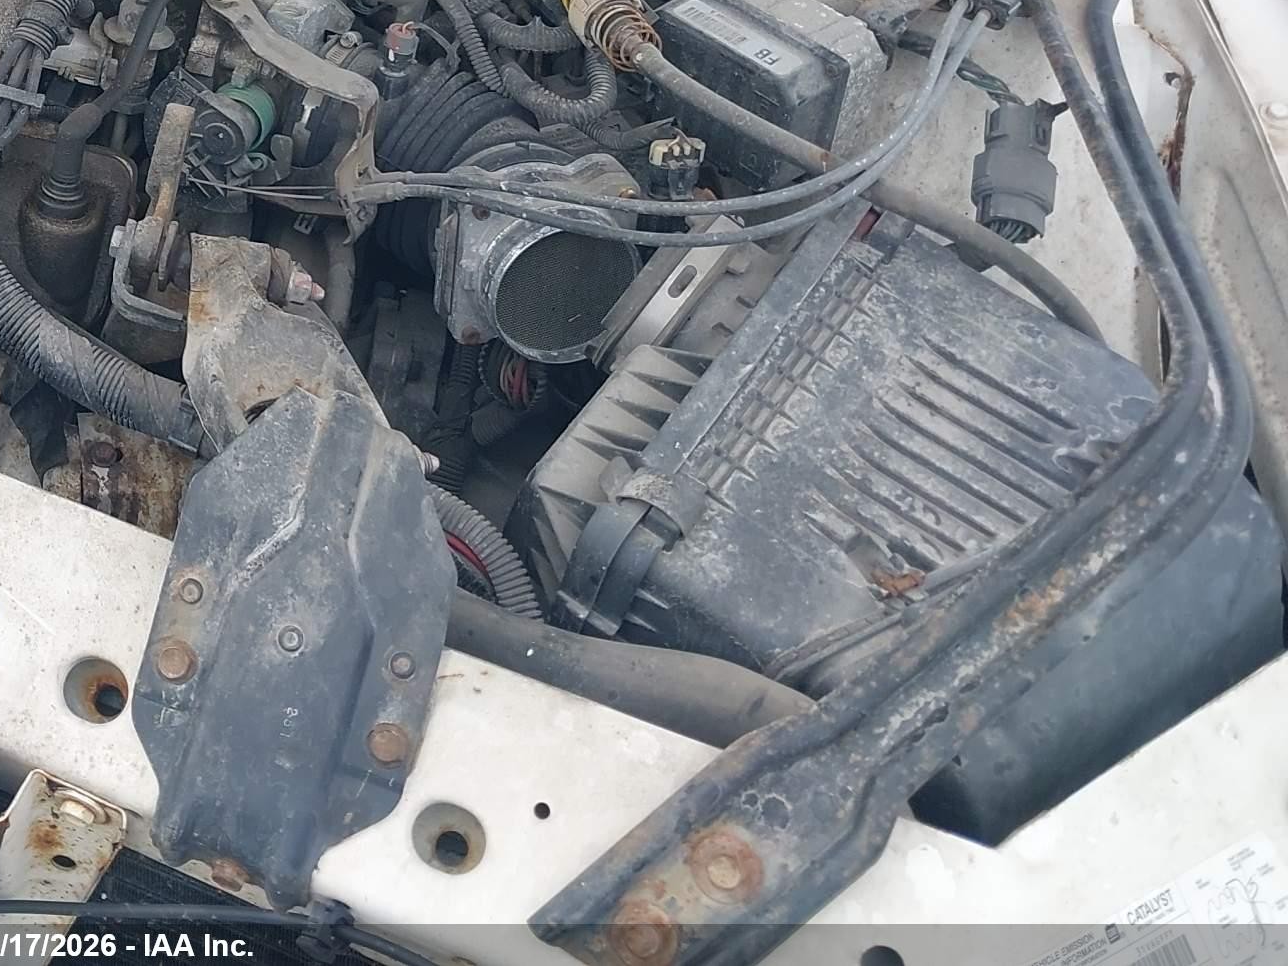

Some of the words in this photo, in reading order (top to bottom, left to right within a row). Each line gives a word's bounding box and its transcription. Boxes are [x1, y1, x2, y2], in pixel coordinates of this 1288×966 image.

[754, 48, 782, 67] FB
[1126, 888, 1172, 927] CATALYST
[1061, 932, 1095, 955] EMISSION
